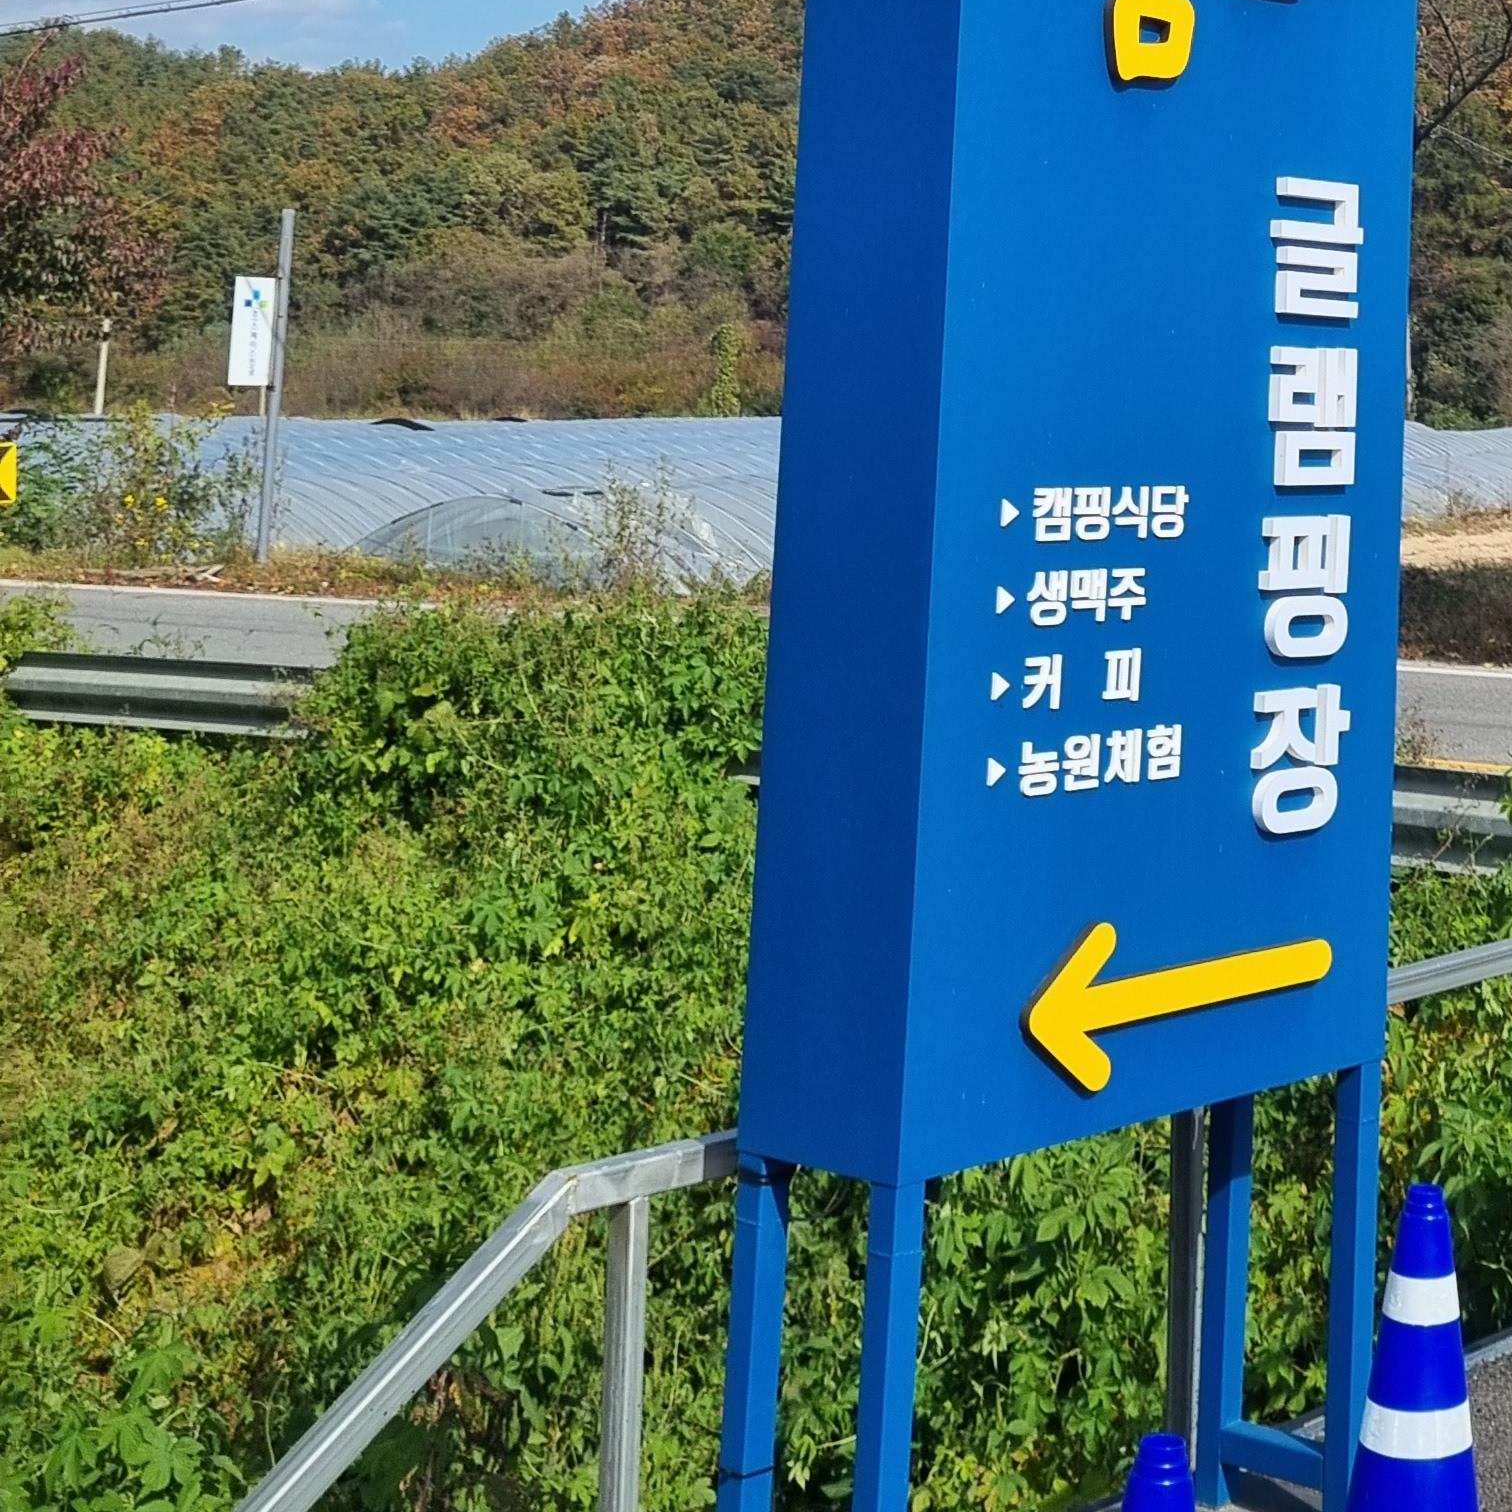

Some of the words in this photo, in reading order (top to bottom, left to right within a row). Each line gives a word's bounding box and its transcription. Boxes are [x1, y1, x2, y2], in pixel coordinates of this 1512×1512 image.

[1032, 485, 1190, 542] 캠핑식당
[1250, 175, 1364, 836] 글램핑장
[1026, 567, 1147, 626] 생맥주
[1018, 723, 1182, 797] 농원체험
